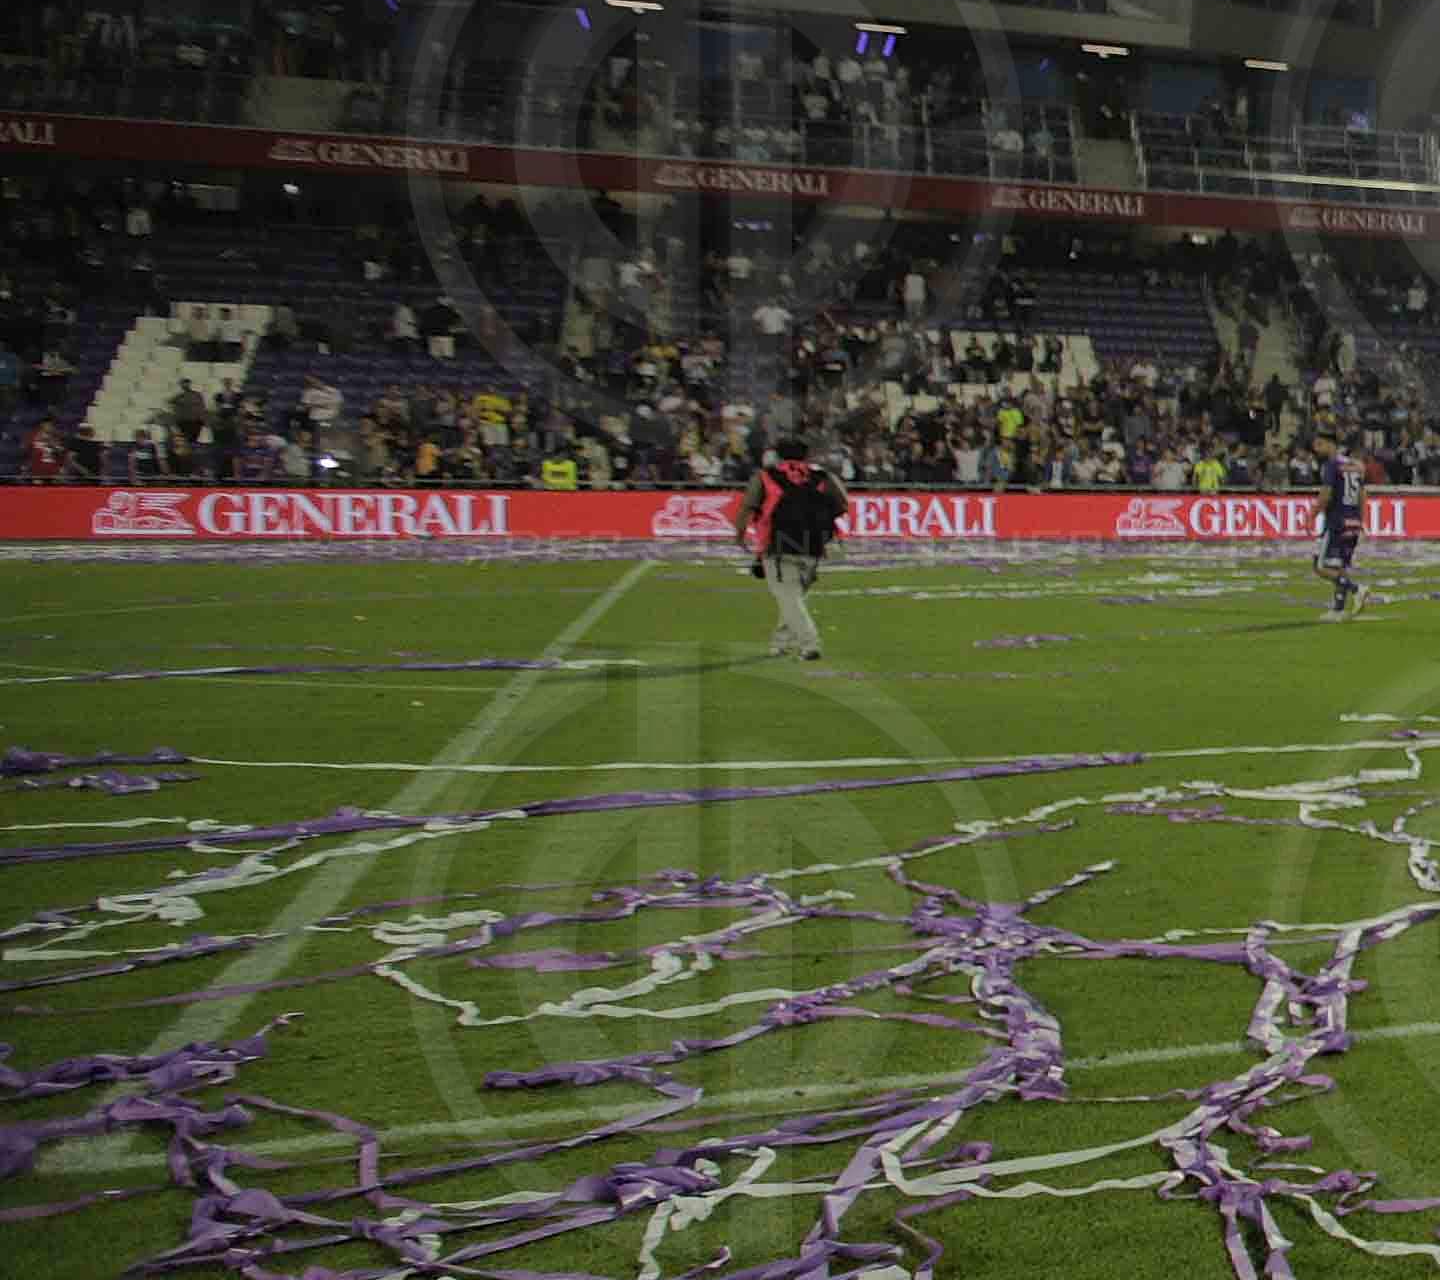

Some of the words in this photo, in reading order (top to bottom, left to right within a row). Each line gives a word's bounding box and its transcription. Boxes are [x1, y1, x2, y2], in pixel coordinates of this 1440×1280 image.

[317, 139, 469, 175] GENERALI
[696, 166, 829, 196] GENERALI
[1028, 188, 1145, 217] GENERALI
[1321, 207, 1428, 234] GENERALI
[1342, 470, 1360, 504] 15
[199, 493, 509, 536] GENERALI
